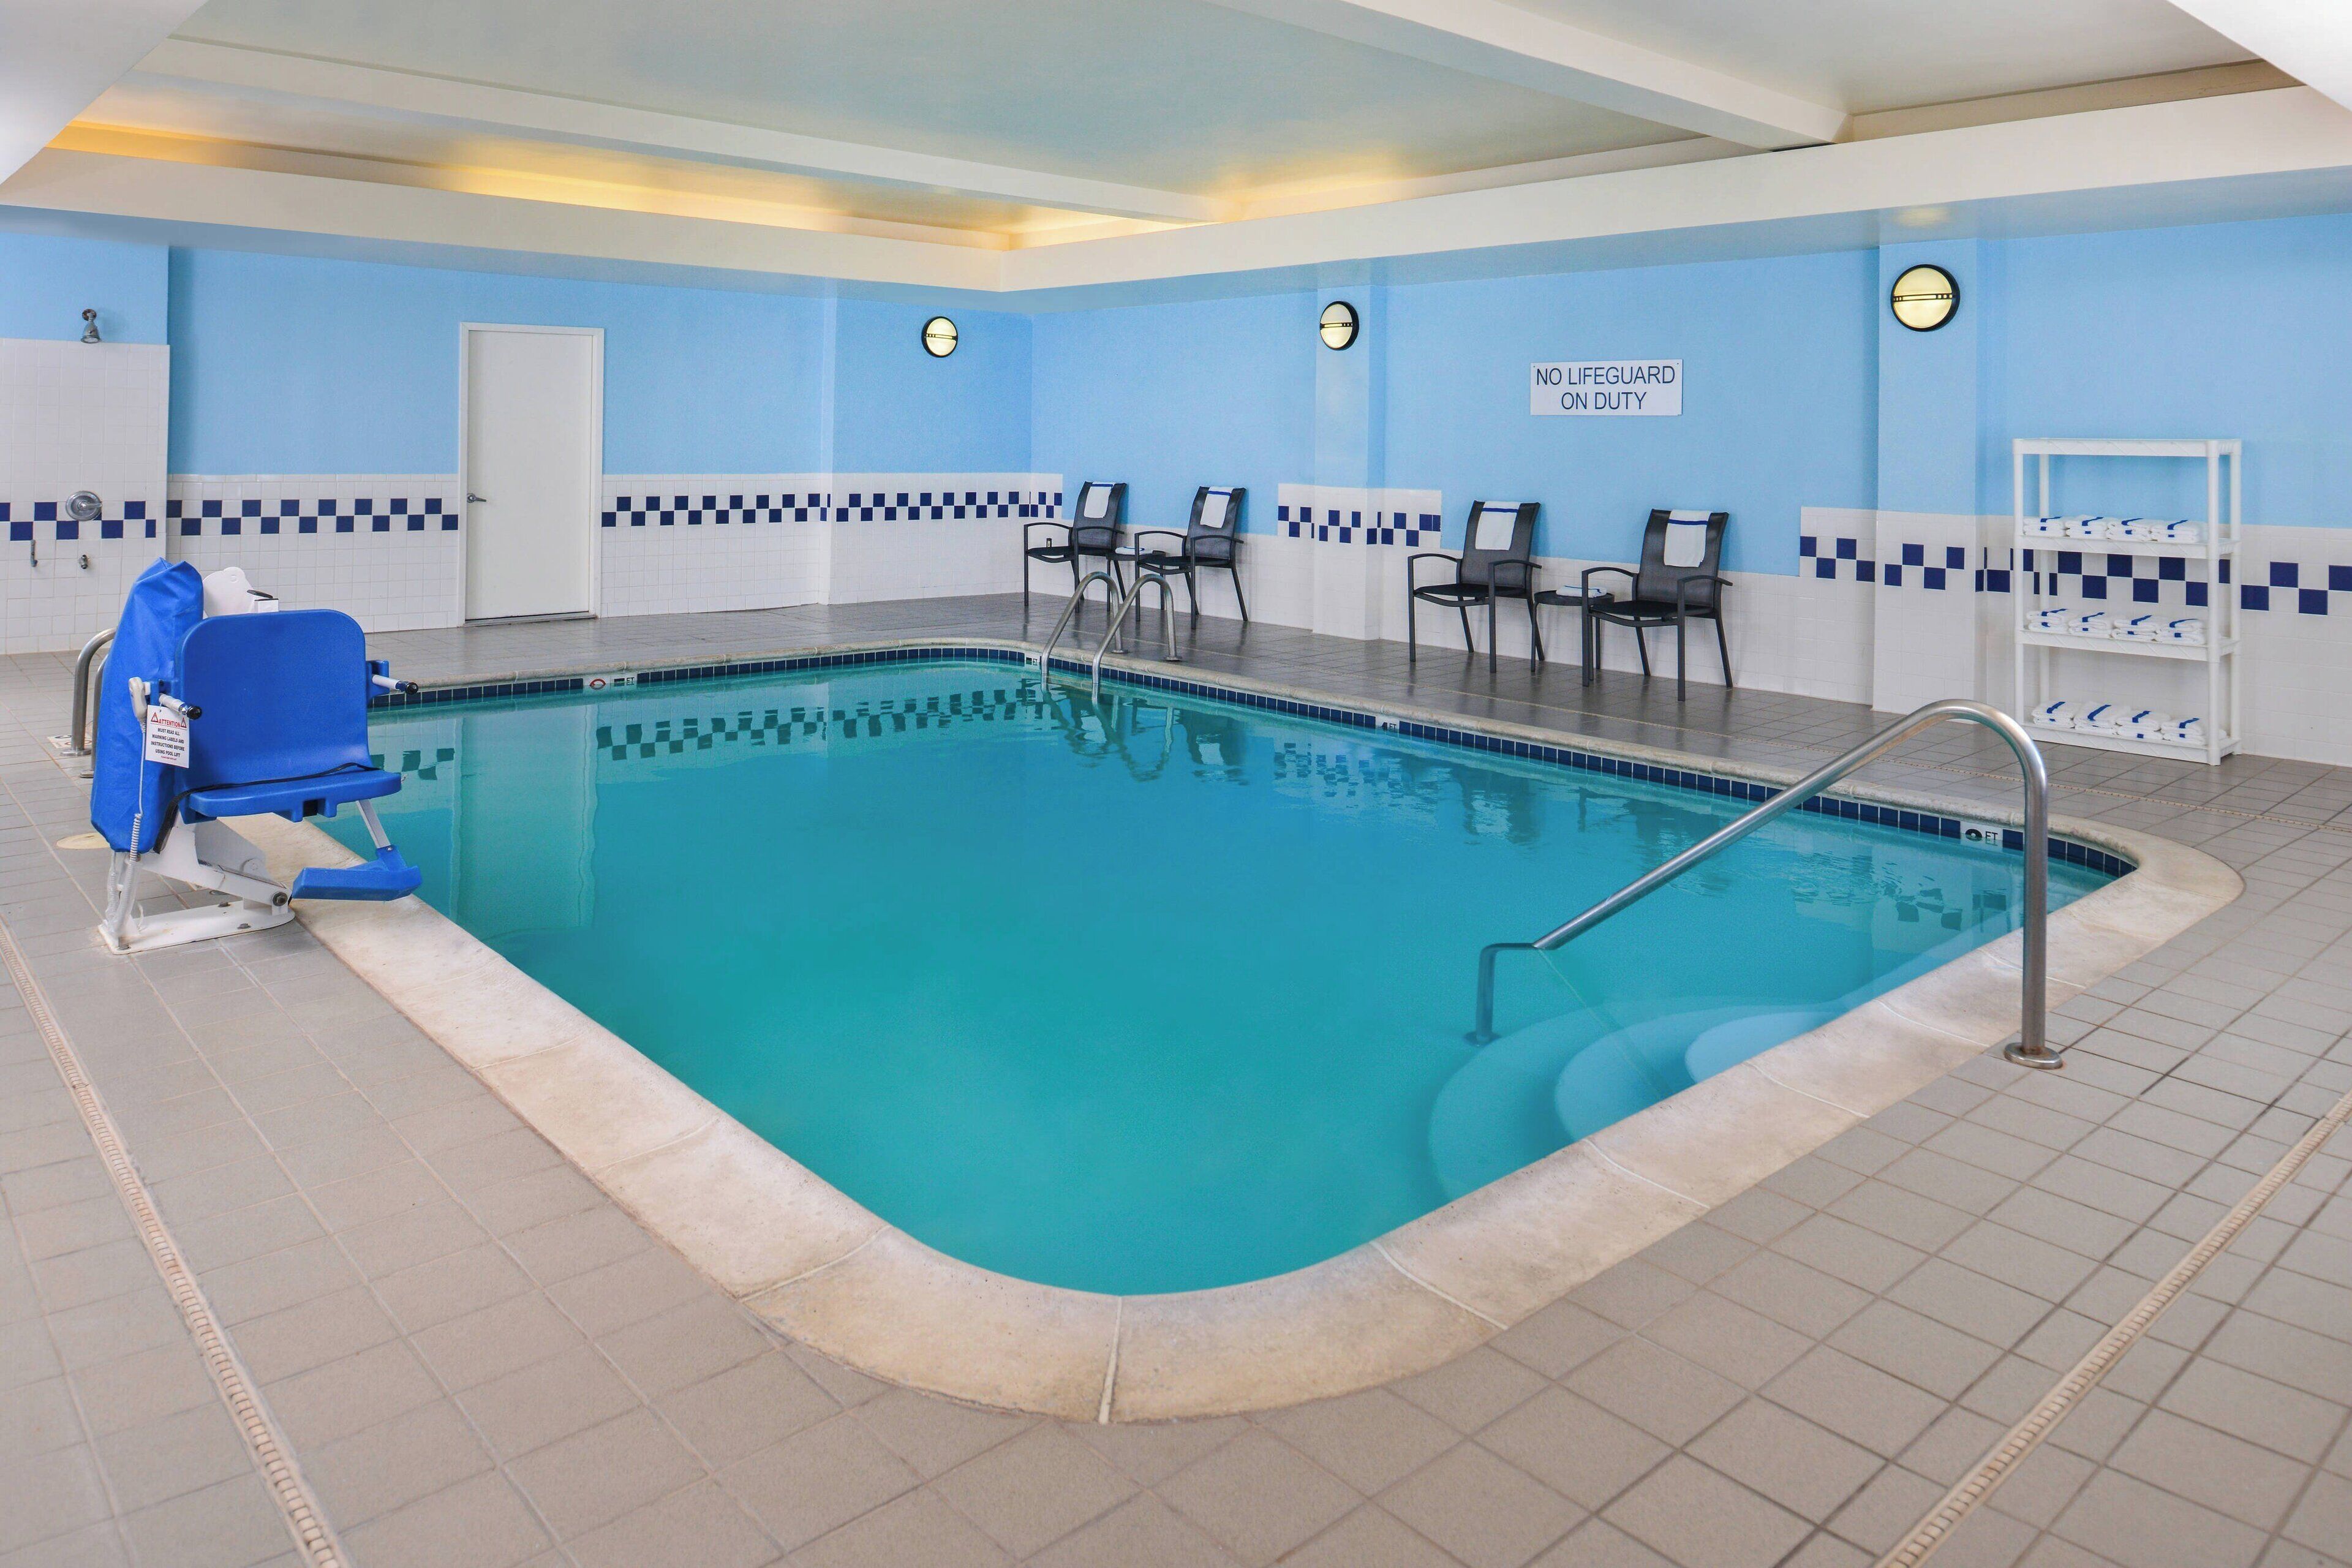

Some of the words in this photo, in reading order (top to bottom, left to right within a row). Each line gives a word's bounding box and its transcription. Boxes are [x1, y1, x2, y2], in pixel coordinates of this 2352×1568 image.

[1536, 368, 1562, 386] NO
[1568, 366, 1676, 385] LIFEGUARD
[1561, 392, 1588, 410] ON
[1594, 391, 1647, 410] DUTY
